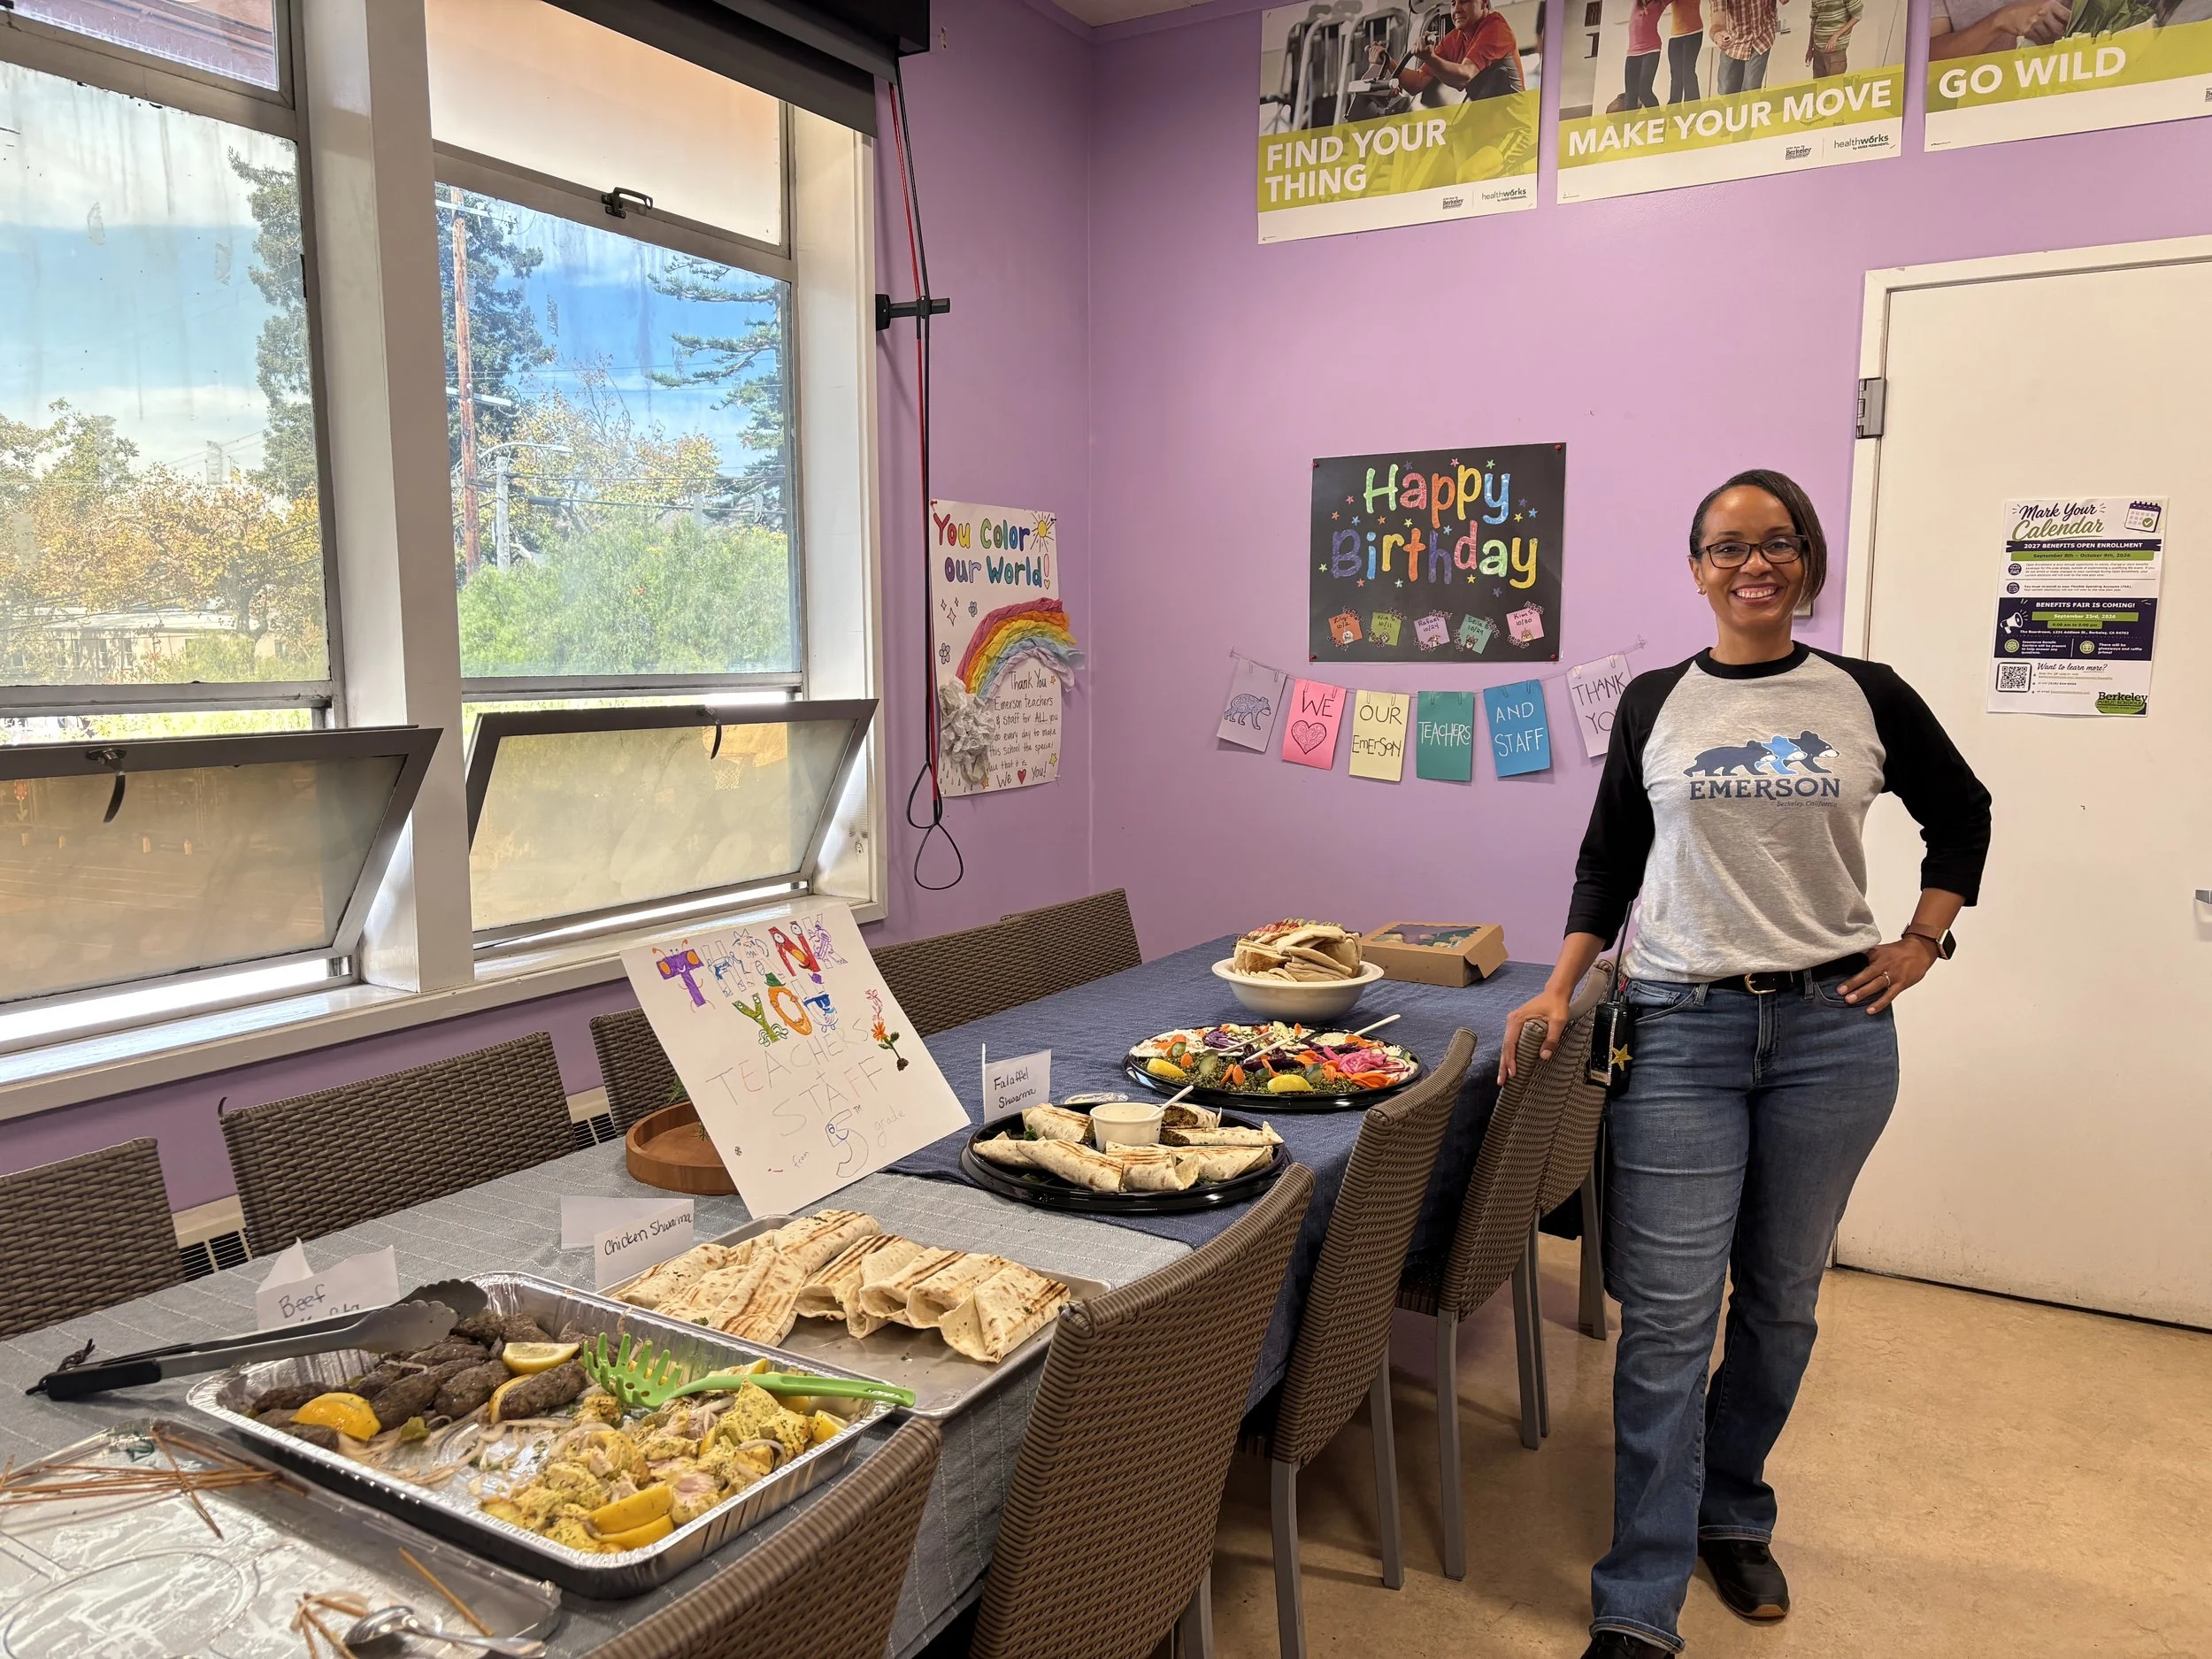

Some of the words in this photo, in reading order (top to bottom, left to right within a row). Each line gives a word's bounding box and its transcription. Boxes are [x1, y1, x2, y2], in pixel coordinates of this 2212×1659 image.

[1939, 64, 2004, 99] GO
[2015, 45, 2127, 87] WILD
[1568, 113, 1666, 157] MAKE
[1674, 101, 1771, 143] YOUR
[1782, 79, 1892, 122] MOVE
[1266, 136, 1344, 172] FIND
[1353, 119, 1446, 155] YOUR
[1265, 164, 1366, 204] THING
[1363, 464, 1510, 528] Happy
[2018, 503, 2061, 520] Mark
[2062, 503, 2098, 521] Your
[933, 512, 971, 549] You
[980, 518, 1031, 550] Color
[2012, 516, 2104, 541] Calendar
[1331, 520, 1539, 589] Birthday
[986, 553, 1051, 589] World!
[1009, 671, 1033, 690] Thank
[1033, 668, 1048, 688] You
[1572, 672, 1626, 706] THANK
[994, 695, 1022, 711] Emerson
[1025, 694, 1053, 709] teachers
[1301, 689, 1334, 718] WE
[1495, 702, 1534, 723] AND
[2098, 692, 2147, 707] Berkeley
[1003, 712, 1019, 725] staff
[1035, 712, 1048, 724] ALL
[1049, 715, 1058, 726] you
[1359, 704, 1402, 726] OUR
[1586, 709, 1617, 734] YO
[1003, 732, 1018, 743] every
[1022, 728, 1031, 739] day
[1417, 720, 1473, 747] TEACHERS
[1494, 727, 1545, 757] STAFF
[989, 745, 1001, 757] this
[1003, 743, 1019, 755] school
[1001, 760, 1014, 769] that
[996, 772, 1012, 787] We
[1689, 778, 1840, 800] EMERSON
[653, 913, 849, 1013] THANK
[731, 972, 838, 1048] YOU
[706, 1018, 870, 1106] TEACHERS
[772, 1056, 883, 1137] STAFF
[872, 1109, 906, 1148] grade
[604, 1229, 648, 1256] Chicken
[279, 1284, 326, 1318] Beef
